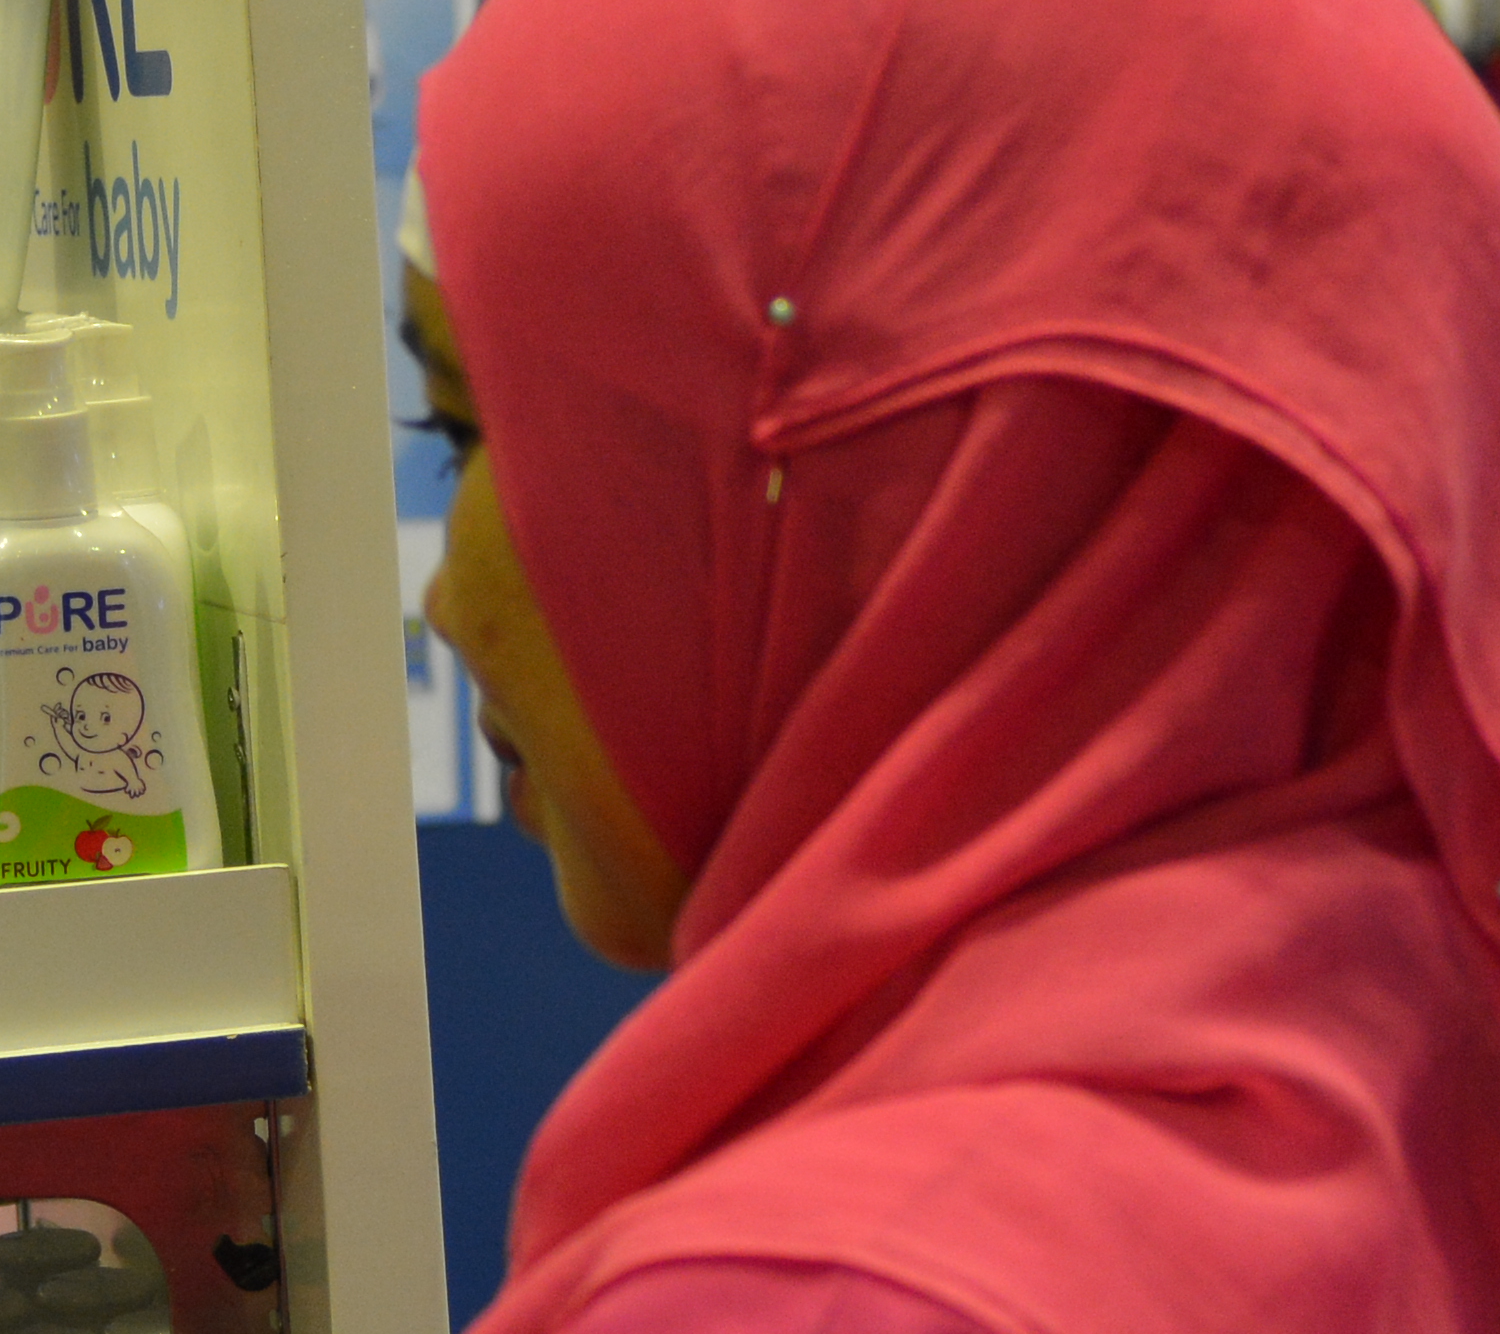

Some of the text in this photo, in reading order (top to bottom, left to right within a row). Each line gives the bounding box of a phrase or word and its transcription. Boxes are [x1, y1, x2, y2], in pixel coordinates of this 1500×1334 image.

[83, 140, 181, 321] baby
[37, 645, 59, 655] Care
[63, 644, 78, 653] For
[82, 635, 129, 654] baby
[0, 858, 73, 880] FRUITY
